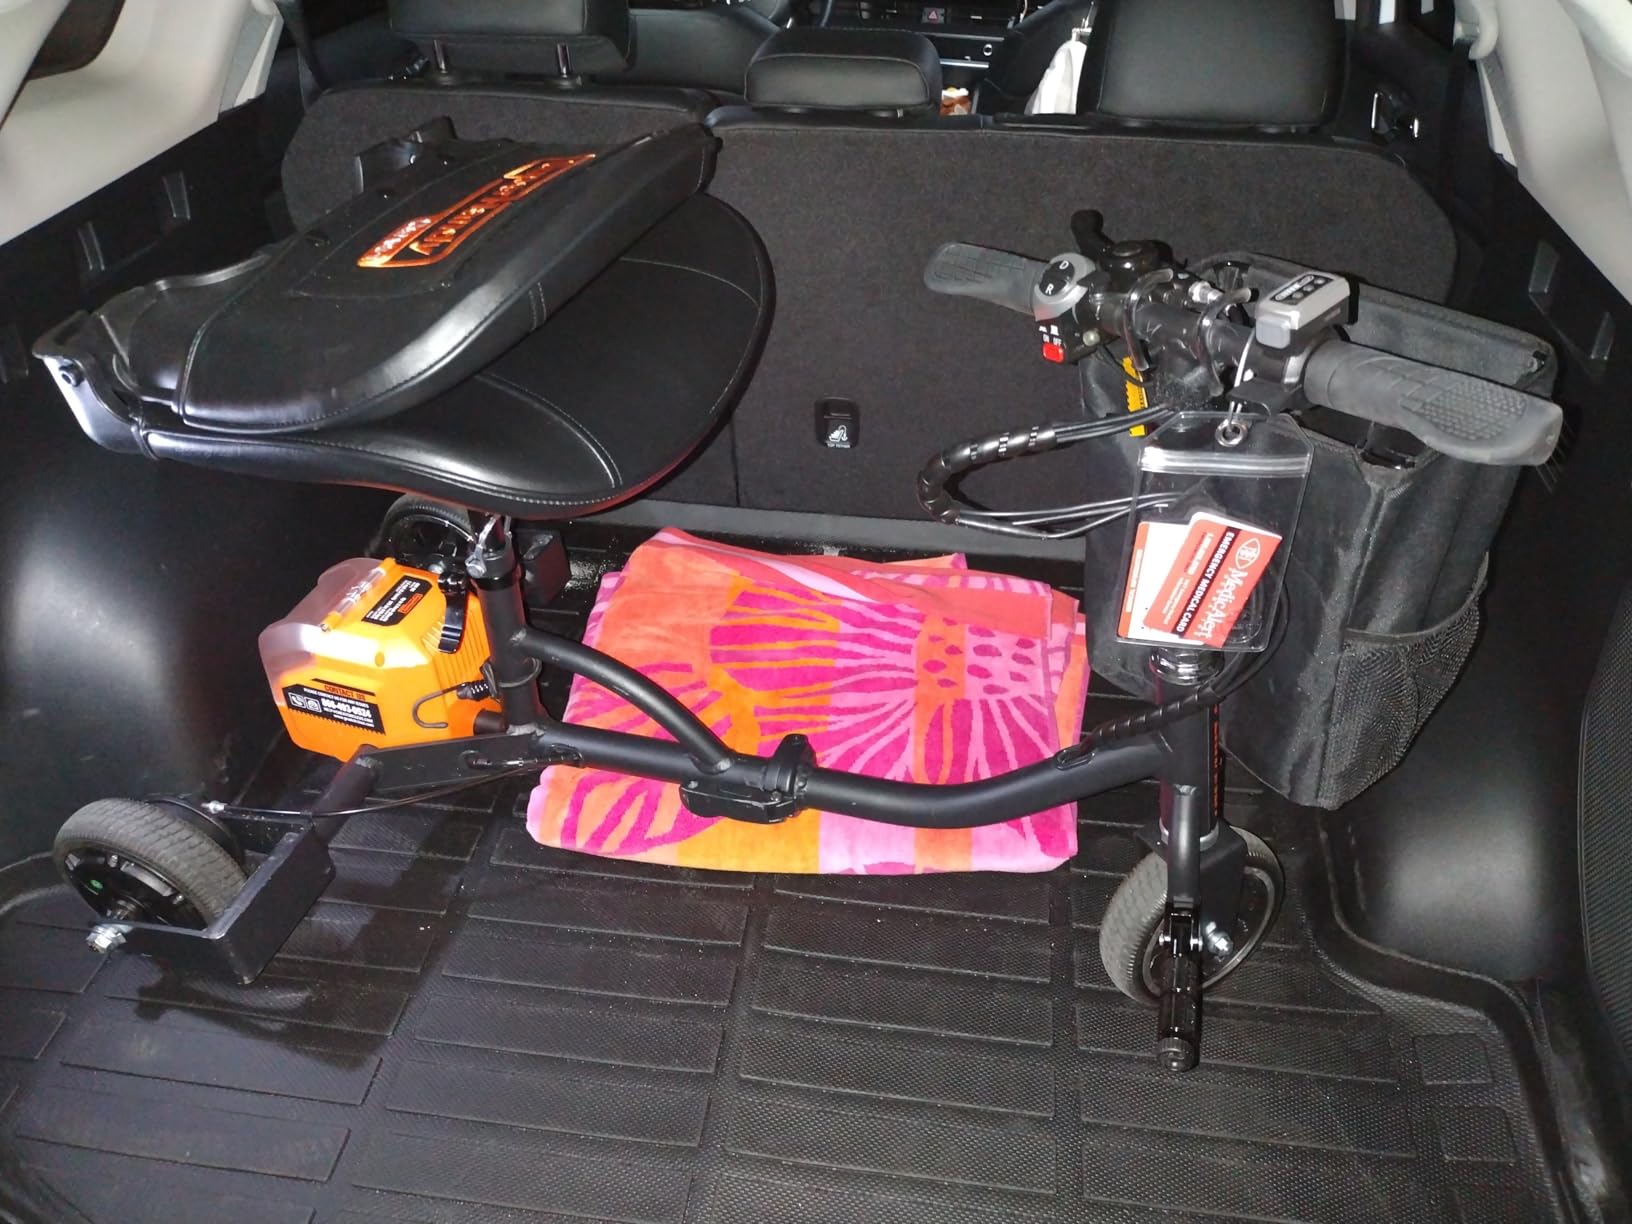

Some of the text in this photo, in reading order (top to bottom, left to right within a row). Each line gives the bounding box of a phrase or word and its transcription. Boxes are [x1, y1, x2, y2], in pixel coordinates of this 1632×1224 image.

[1059, 260, 1069, 270] D
[1045, 283, 1055, 295] R
[1204, 531, 1235, 580] EMERGENCY
[1188, 578, 1214, 615] MEDICAL
[1199, 566, 1248, 639] MedicAlert
[1176, 612, 1194, 633] CARD
[324, 684, 354, 698] CONTACT
